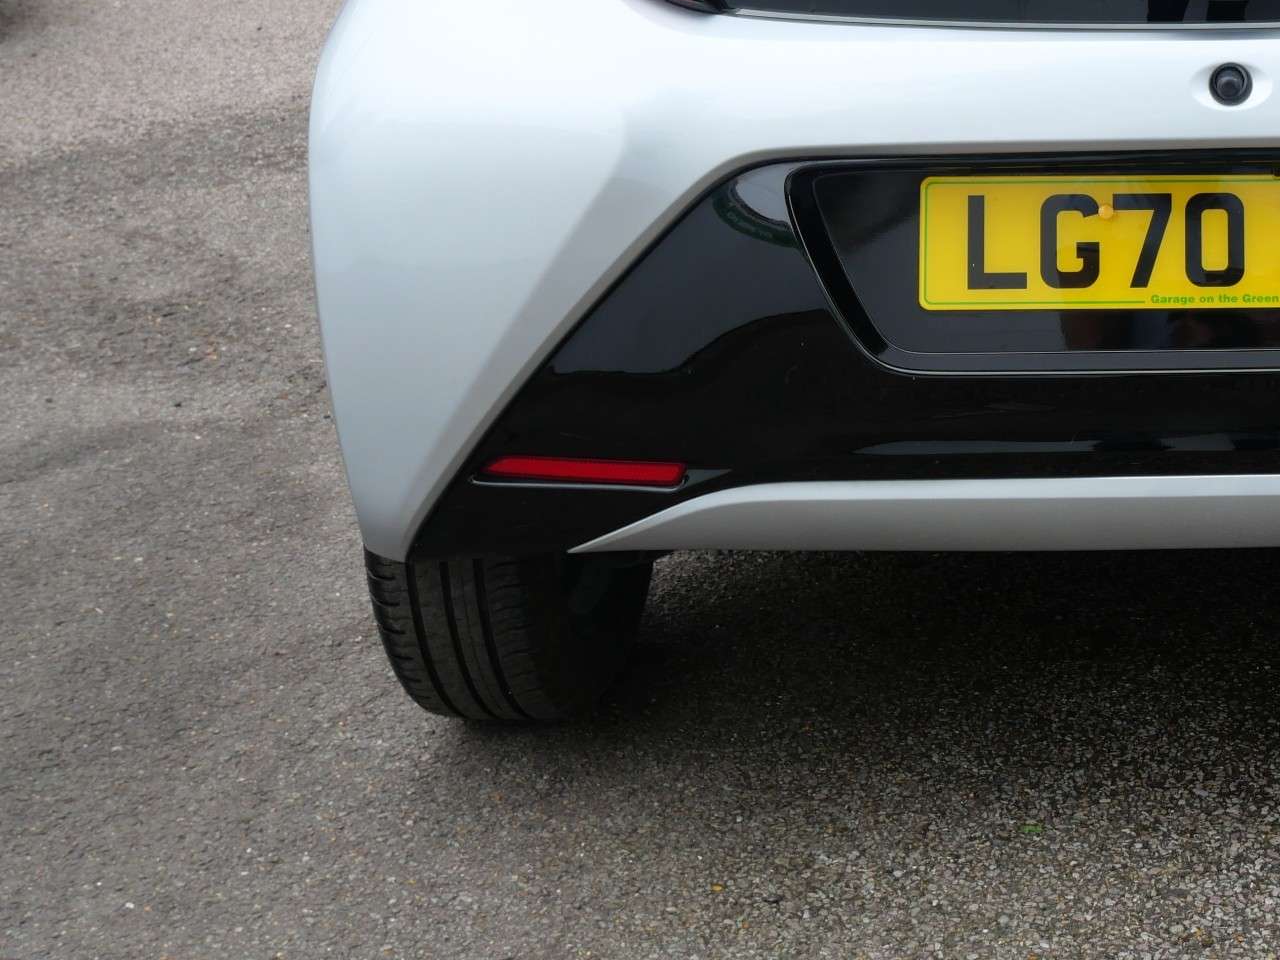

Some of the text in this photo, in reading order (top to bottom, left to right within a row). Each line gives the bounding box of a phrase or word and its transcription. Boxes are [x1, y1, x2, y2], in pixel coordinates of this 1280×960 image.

[967, 192, 1245, 290] LG70
[1150, 294, 1195, 305] Garage
[1218, 294, 1239, 303] the
[1242, 293, 1280, 303] Green
